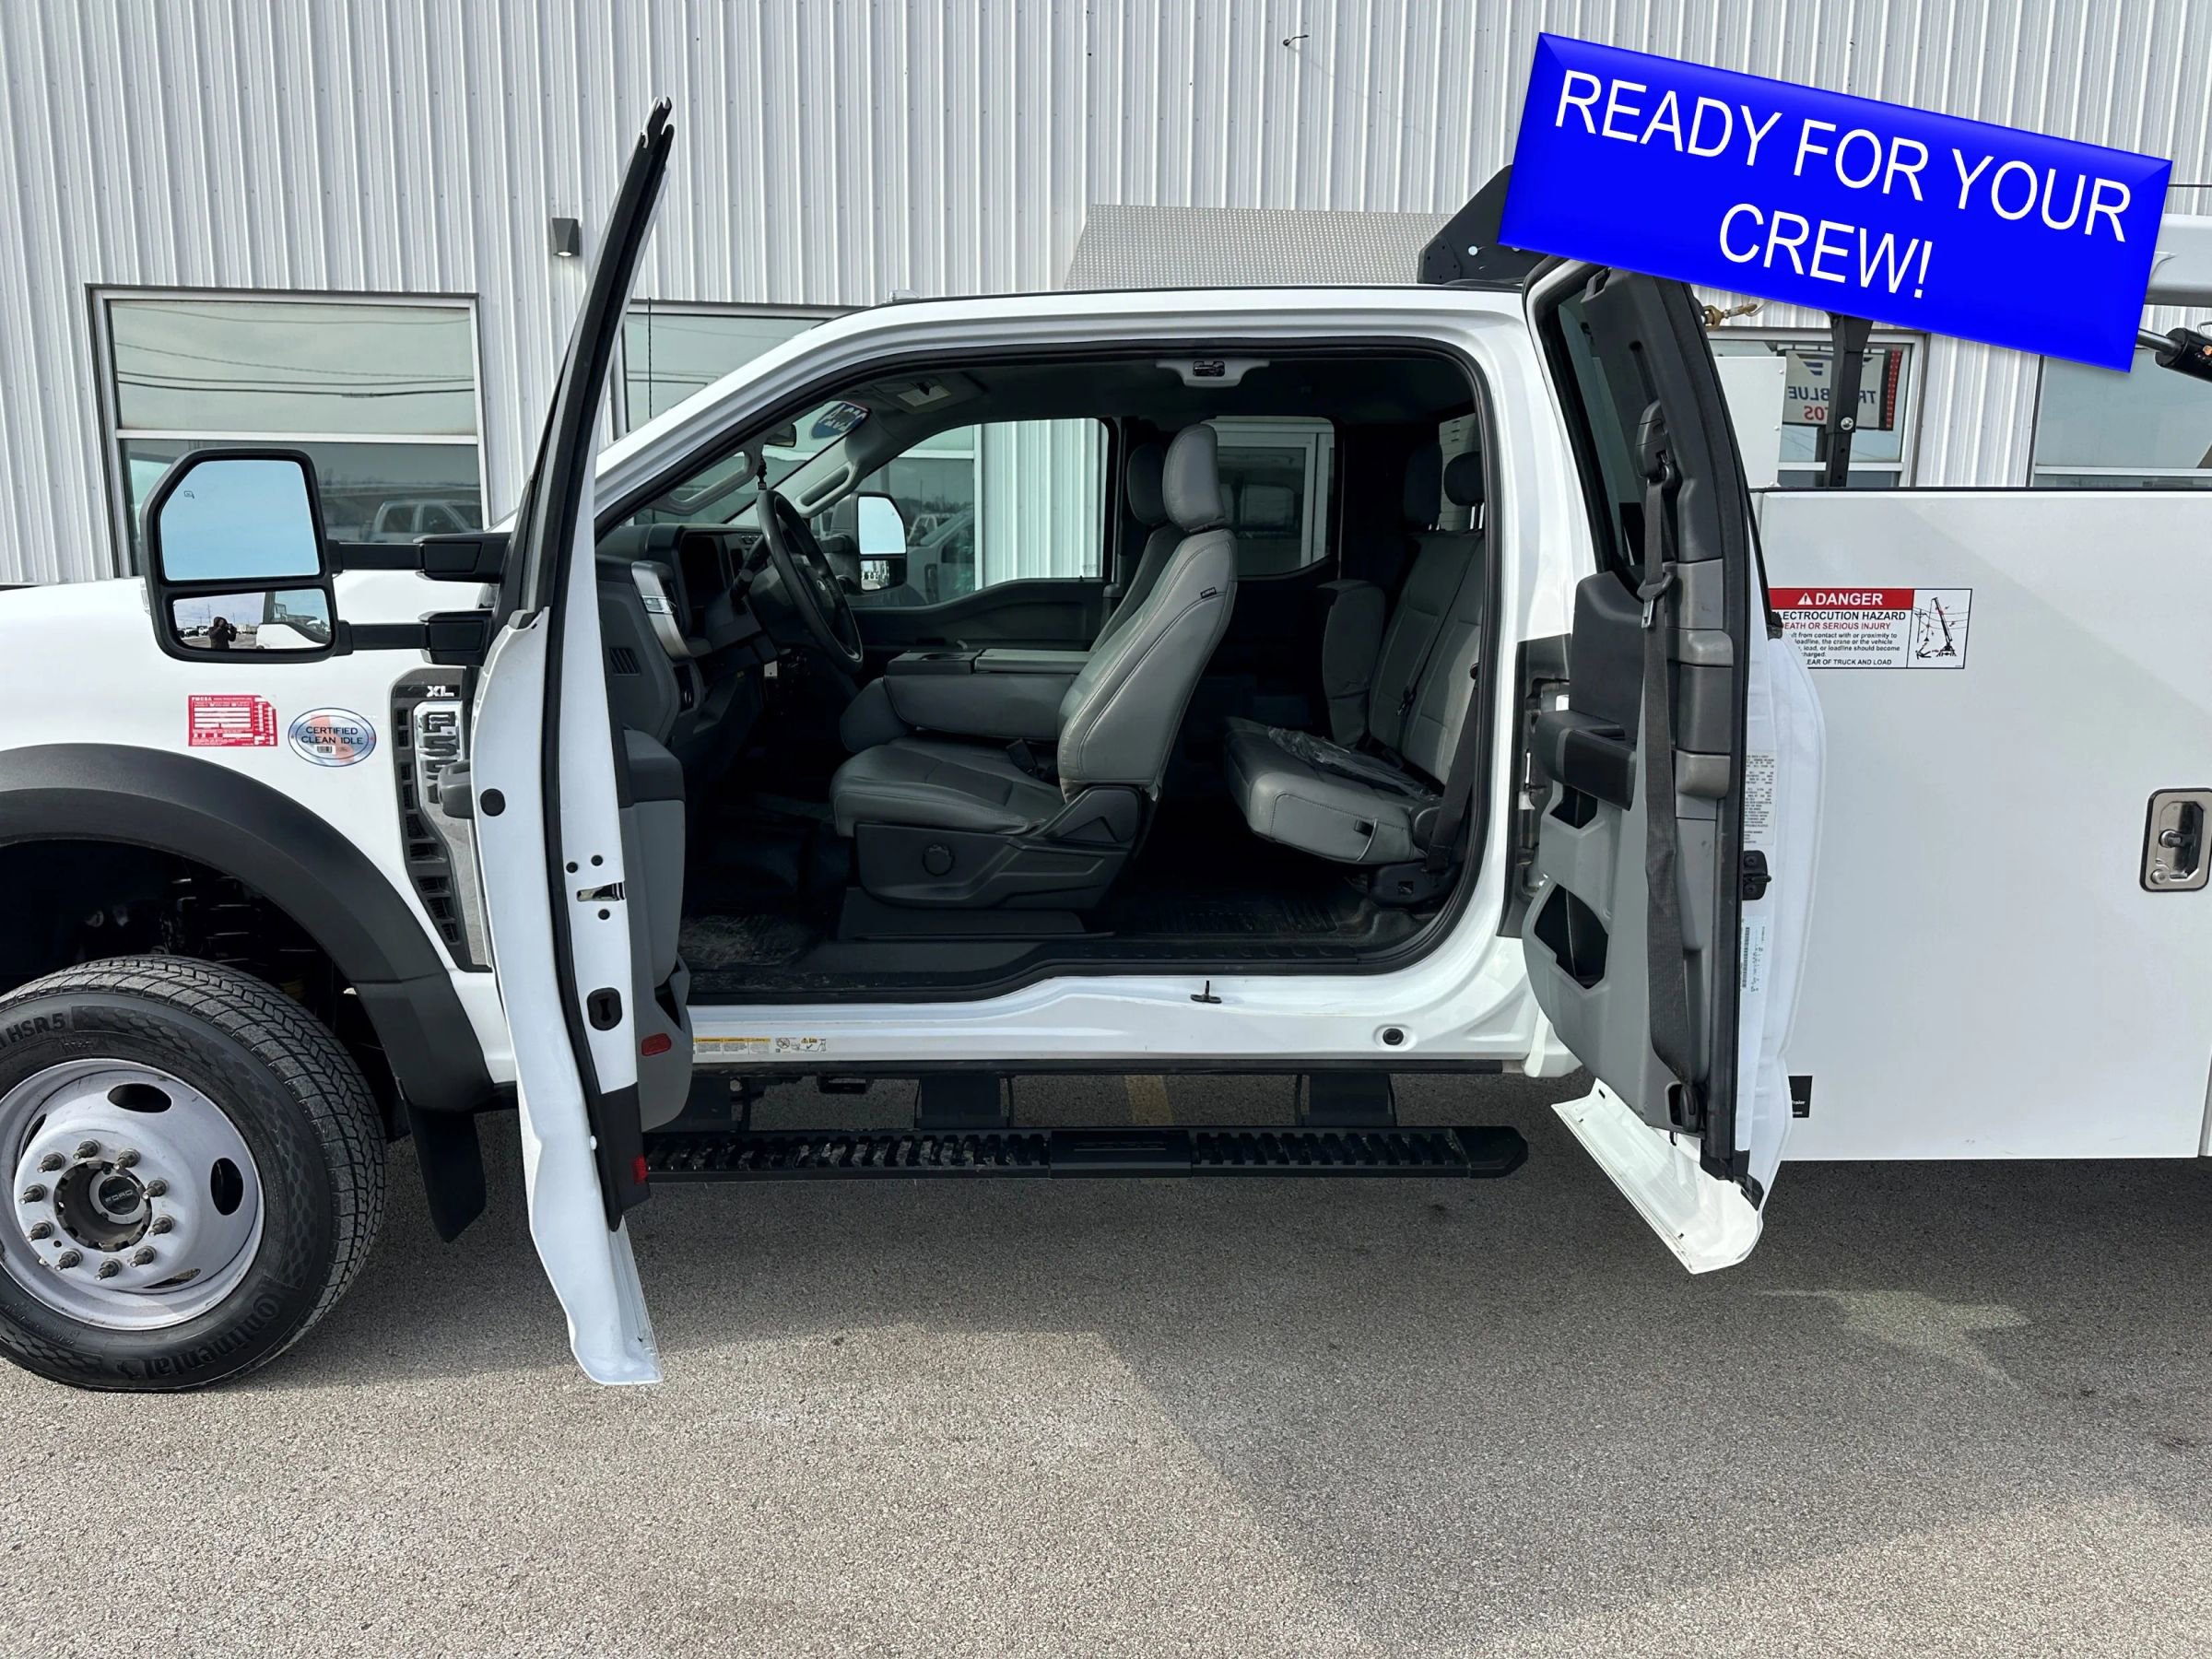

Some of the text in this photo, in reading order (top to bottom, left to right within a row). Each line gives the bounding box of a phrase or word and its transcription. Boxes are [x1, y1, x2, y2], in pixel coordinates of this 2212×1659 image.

[1815, 593, 1883, 606] DANGER
[1782, 611, 1906, 620] ECTROCUTION HAZARD
[1861, 632, 1889, 641] proximity
[426, 685, 455, 698] XL
[305, 725, 359, 735] CERTIFIED
[300, 735, 364, 745] CLEAN IDLE
[104, 1188, 134, 1203] FORD
